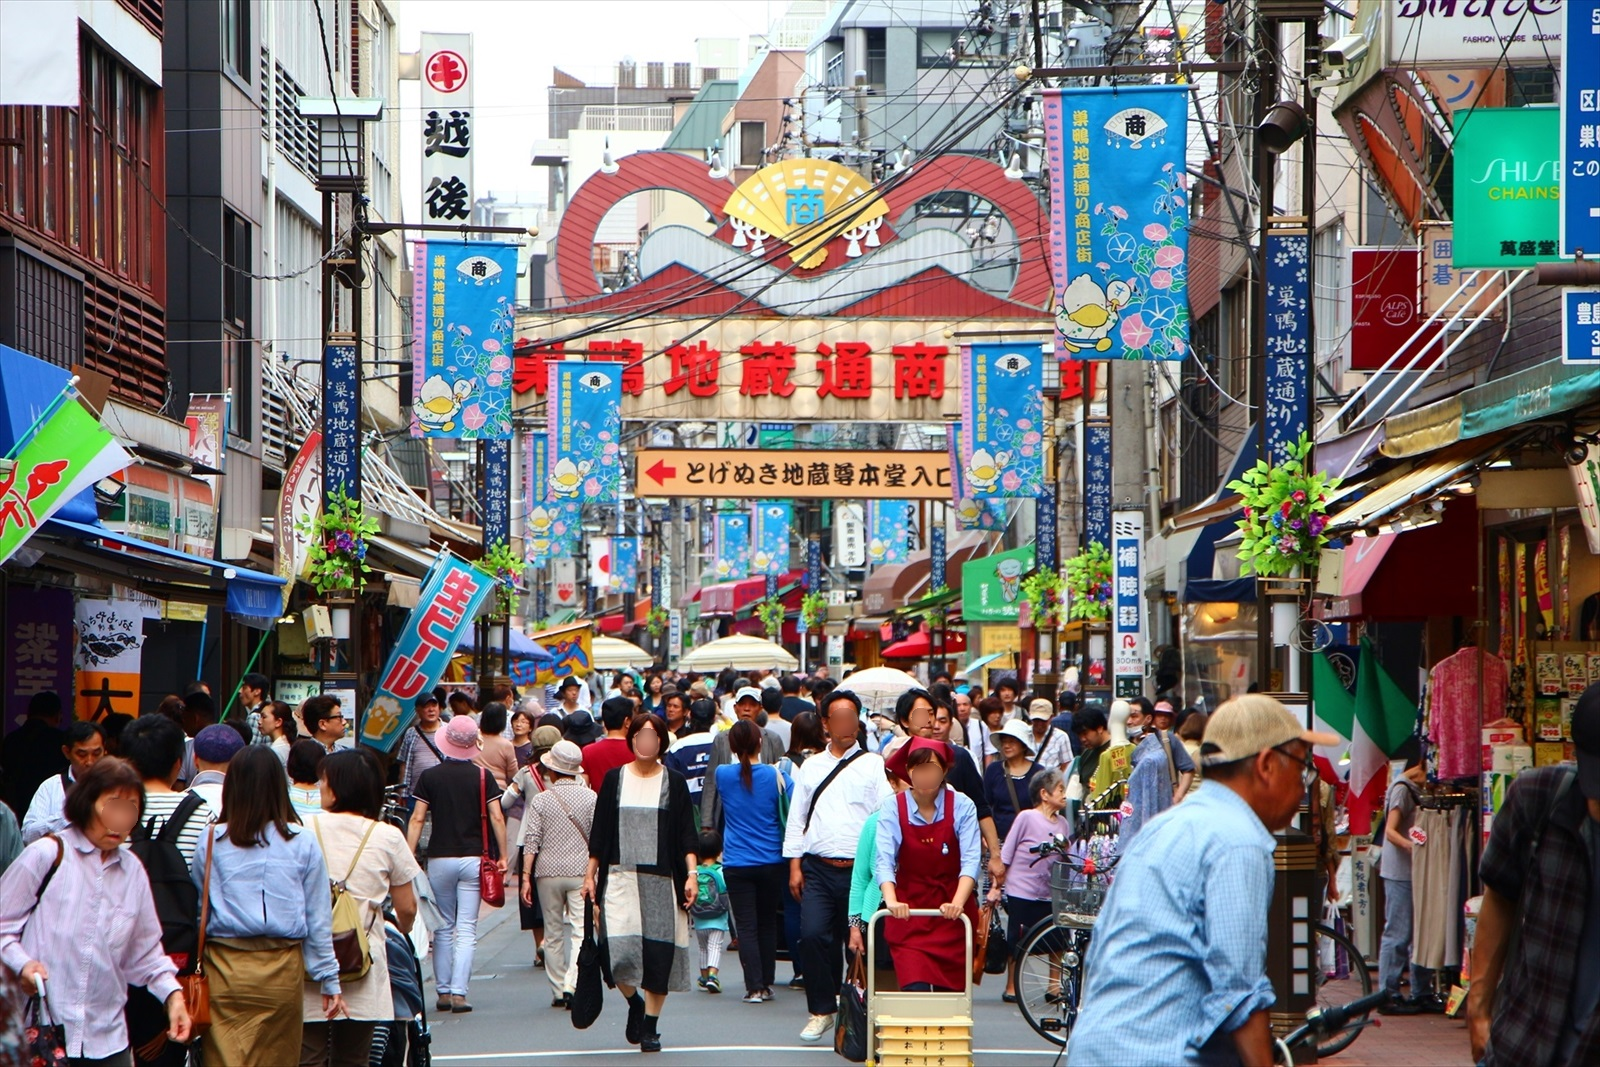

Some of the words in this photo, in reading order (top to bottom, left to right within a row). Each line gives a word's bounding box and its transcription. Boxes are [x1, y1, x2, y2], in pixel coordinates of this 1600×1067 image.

[1463, 35, 1495, 43] FASHION
[1500, 35, 1526, 43] HOUSE
[1580, 89, 1600, 112] 区
[1124, 114, 1146, 137] 商
[1579, 125, 1600, 148] 巣
[424, 110, 471, 220] 越後
[1572, 160, 1600, 177] この
[1072, 110, 1092, 263] 巣鴨地蔵通り商店街
[1488, 186, 1560, 200] CHAINS
[785, 186, 825, 226] 商
[1500, 239, 1559, 256] 萬盛堂
[471, 261, 487, 277] 商
[1432, 239, 1453, 286] 囲碁
[432, 255, 446, 367] 巣鴨地蔵通り商店街
[1386, 301, 1408, 310] ALPS
[1006, 357, 1019, 370] 商
[1275, 286, 1298, 426] 巣鴨地蔵通り
[590, 374, 601, 387] 商
[332, 381, 349, 481] 巣鴨地蔵通り
[686, 460, 951, 488] とげぬき地蔵尊本堂入口
[490, 463, 503, 535] 巣鴨地蔵通り
[1091, 455, 1106, 534] 巣鴨地蔵通り
[1115, 521, 1141, 536] ミミー
[1118, 546, 1139, 627] 補聴器
[381, 567, 479, 700] 生ビール
[14, 622, 59, 726] 紫芋
[1119, 688, 1140, 696] 3-16
